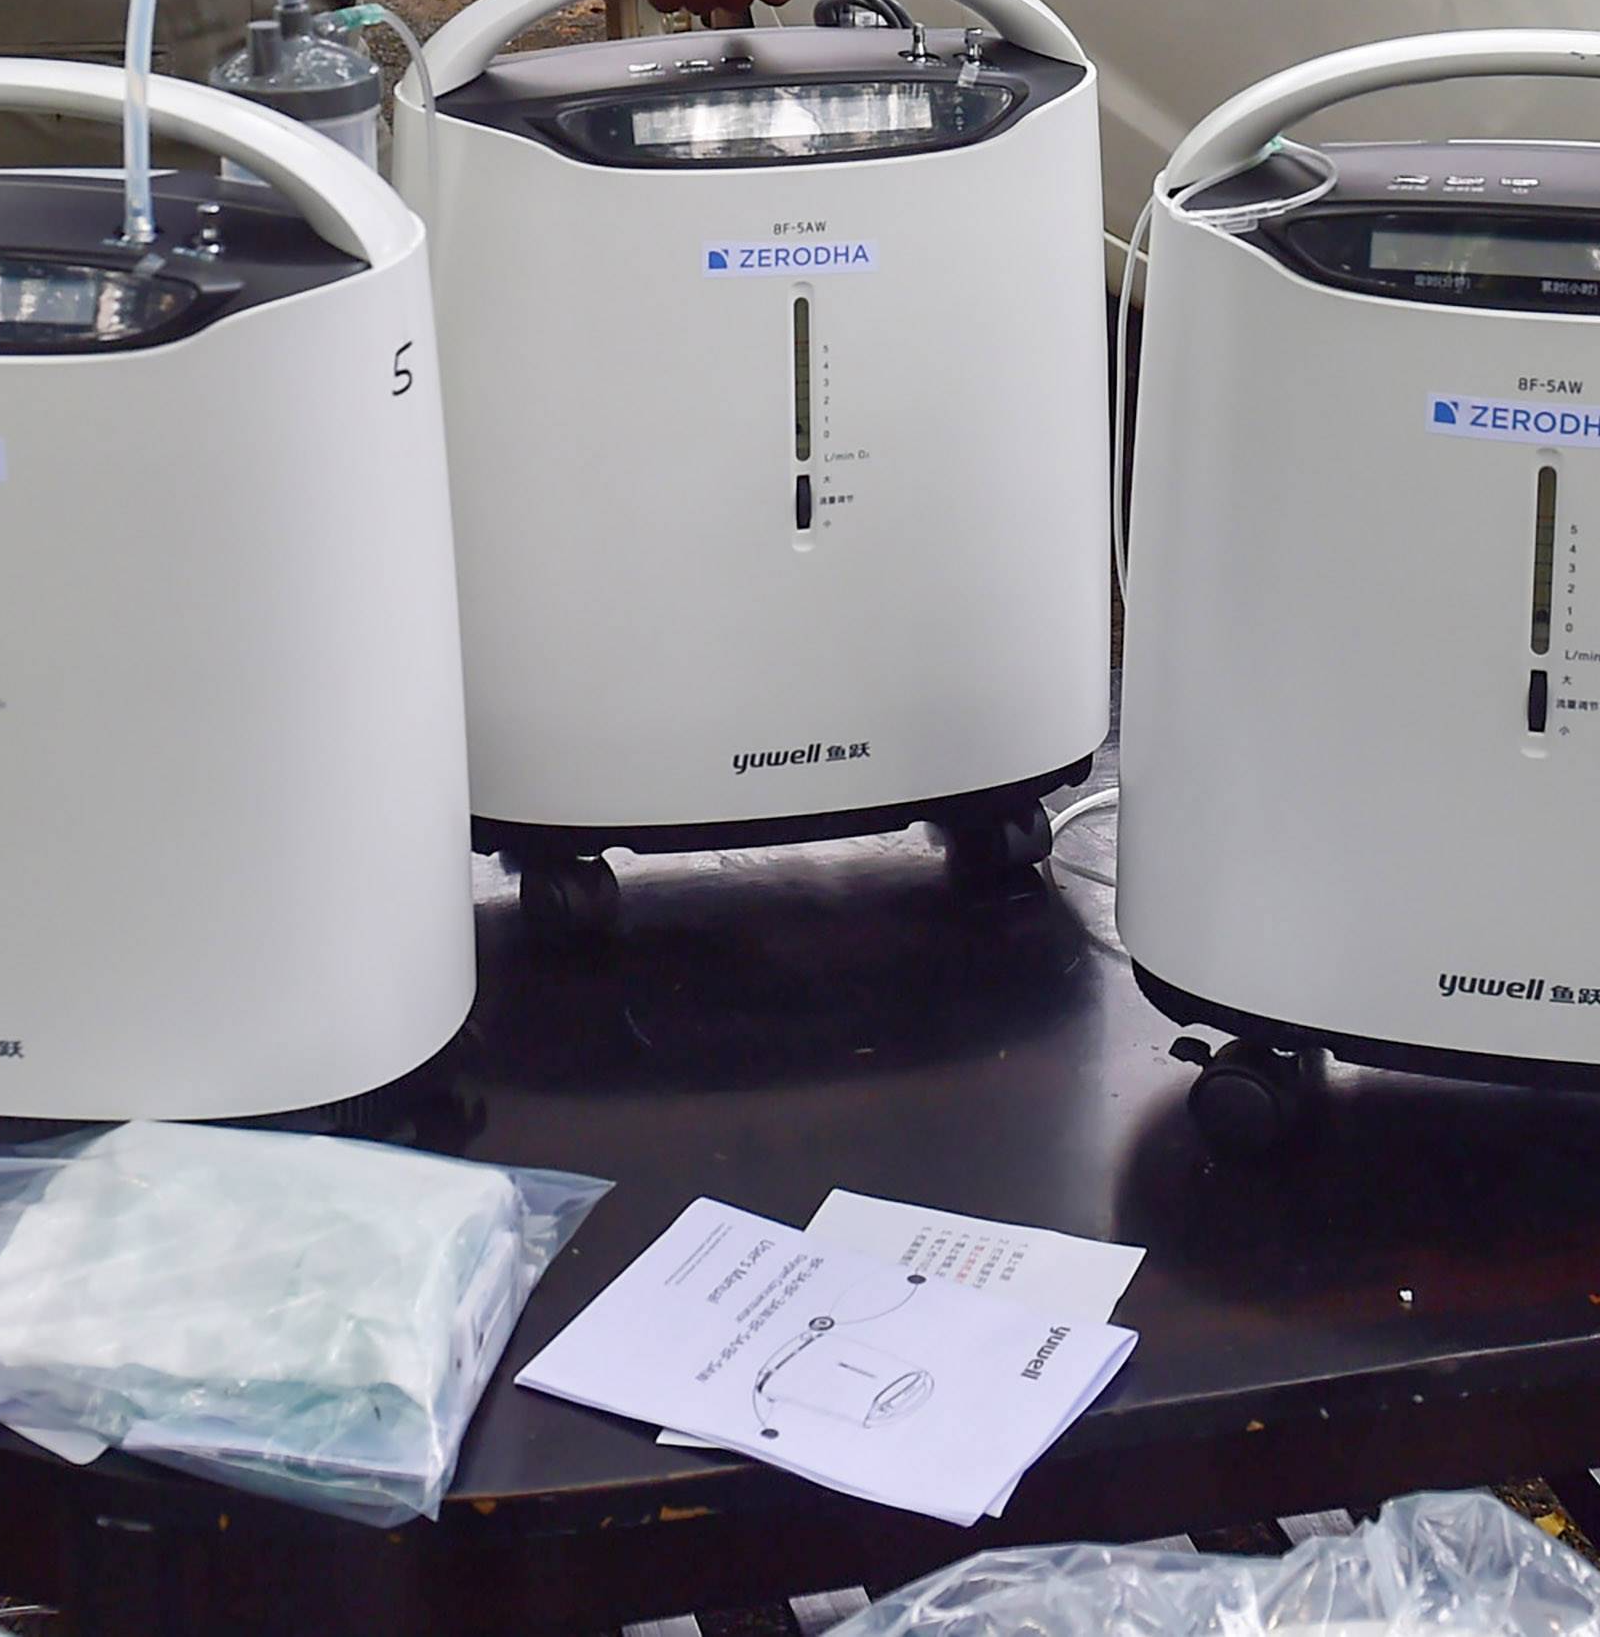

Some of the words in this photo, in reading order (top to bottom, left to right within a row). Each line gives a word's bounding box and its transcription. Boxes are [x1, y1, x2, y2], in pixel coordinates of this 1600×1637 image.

[739, 244, 869, 269] ZERODHA
[391, 340, 413, 397] 5
[732, 743, 822, 775] yuwell
[1438, 973, 1545, 1001] yuwell
[1020, 1325, 1071, 1381] yuwell
